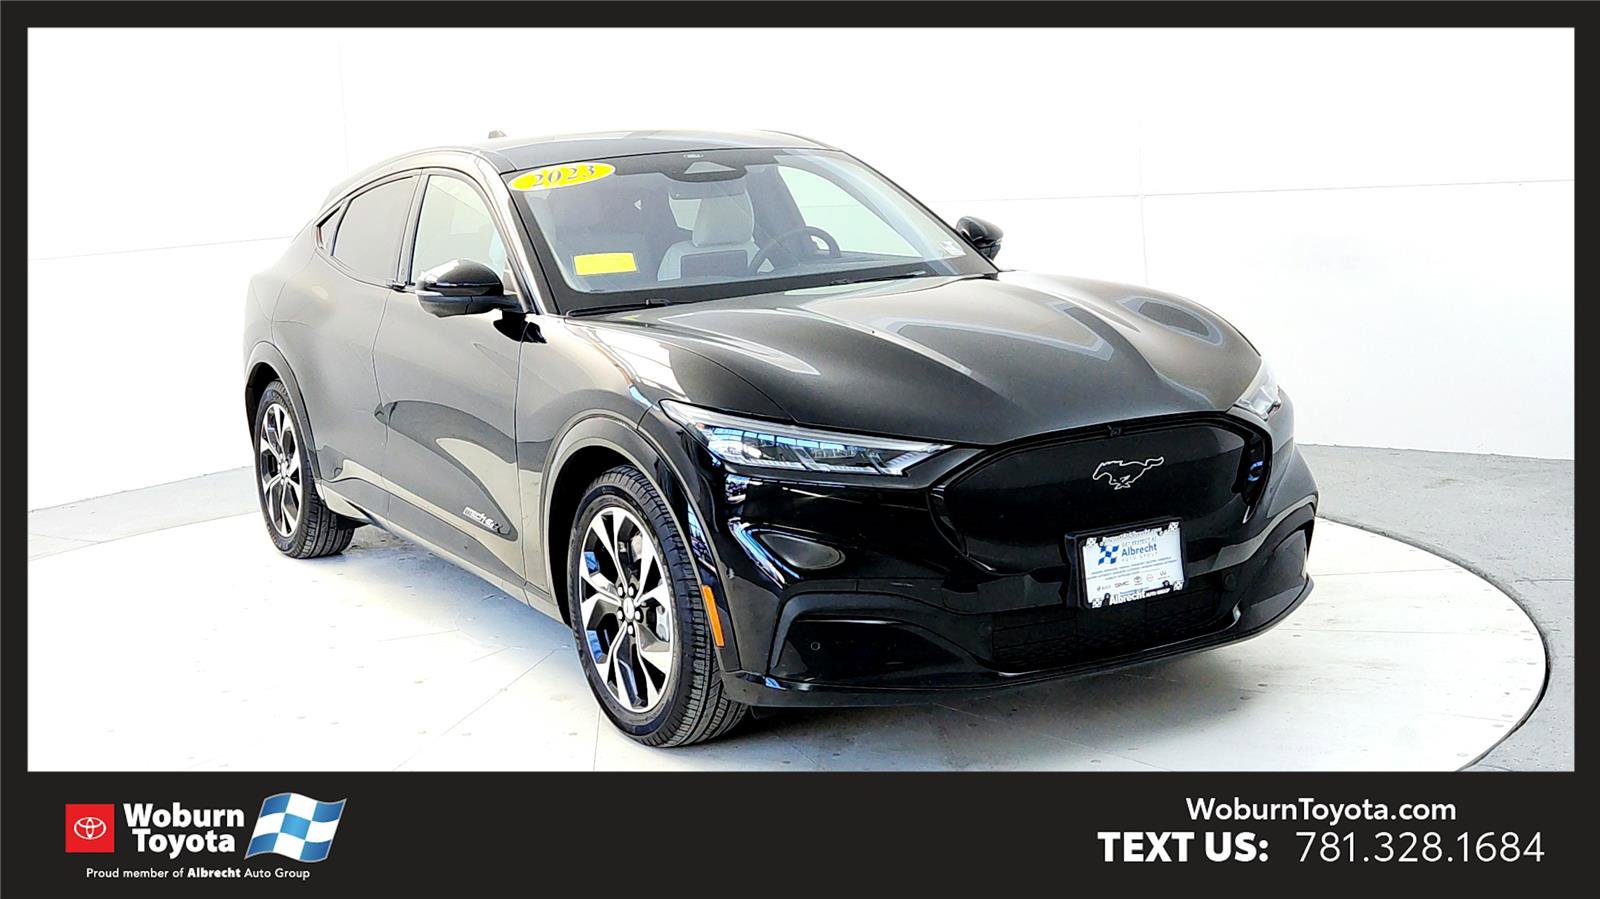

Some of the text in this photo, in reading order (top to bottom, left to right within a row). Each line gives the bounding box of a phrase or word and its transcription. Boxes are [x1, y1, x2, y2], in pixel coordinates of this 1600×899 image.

[532, 165, 595, 187] 2023
[1121, 543, 1158, 557] Albrecht
[1109, 590, 1146, 605] Albrecht
